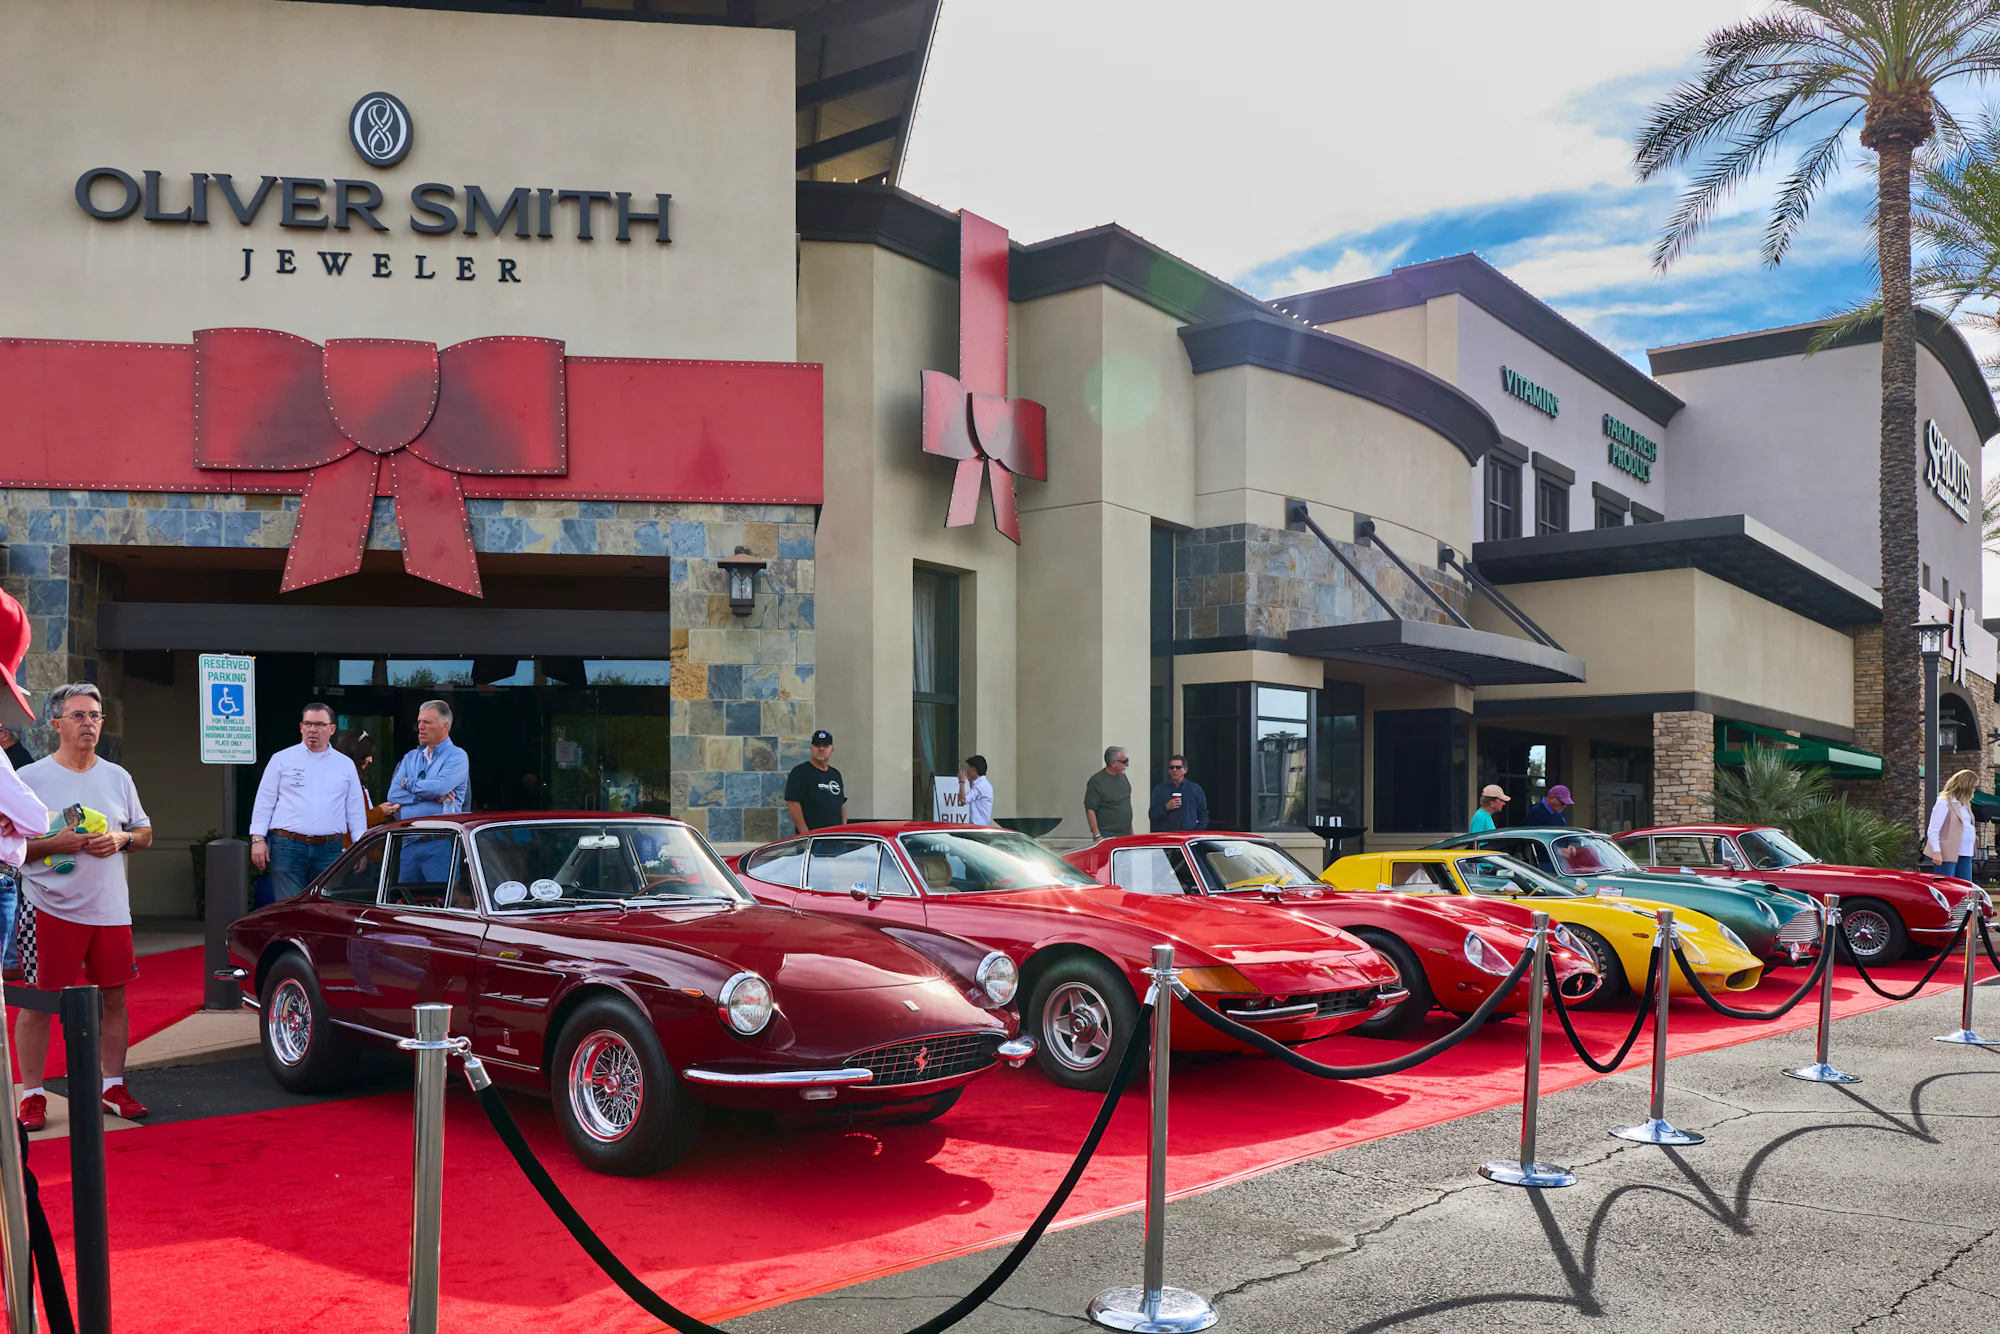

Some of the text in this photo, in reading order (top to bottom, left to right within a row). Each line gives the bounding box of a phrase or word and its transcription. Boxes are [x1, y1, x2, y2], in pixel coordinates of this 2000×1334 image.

[75, 167, 673, 243] OLIVER SMITH
[240, 248, 522, 283] JEWELER
[1502, 365, 1560, 419] VITAMINS
[1604, 414, 1657, 462] FARM FRESH
[1610, 442, 1652, 483] PRODUCE
[1926, 418, 1971, 505] SPROUTS
[203, 659, 250, 670] RESERVED
[207, 671, 247, 683] PARKING
